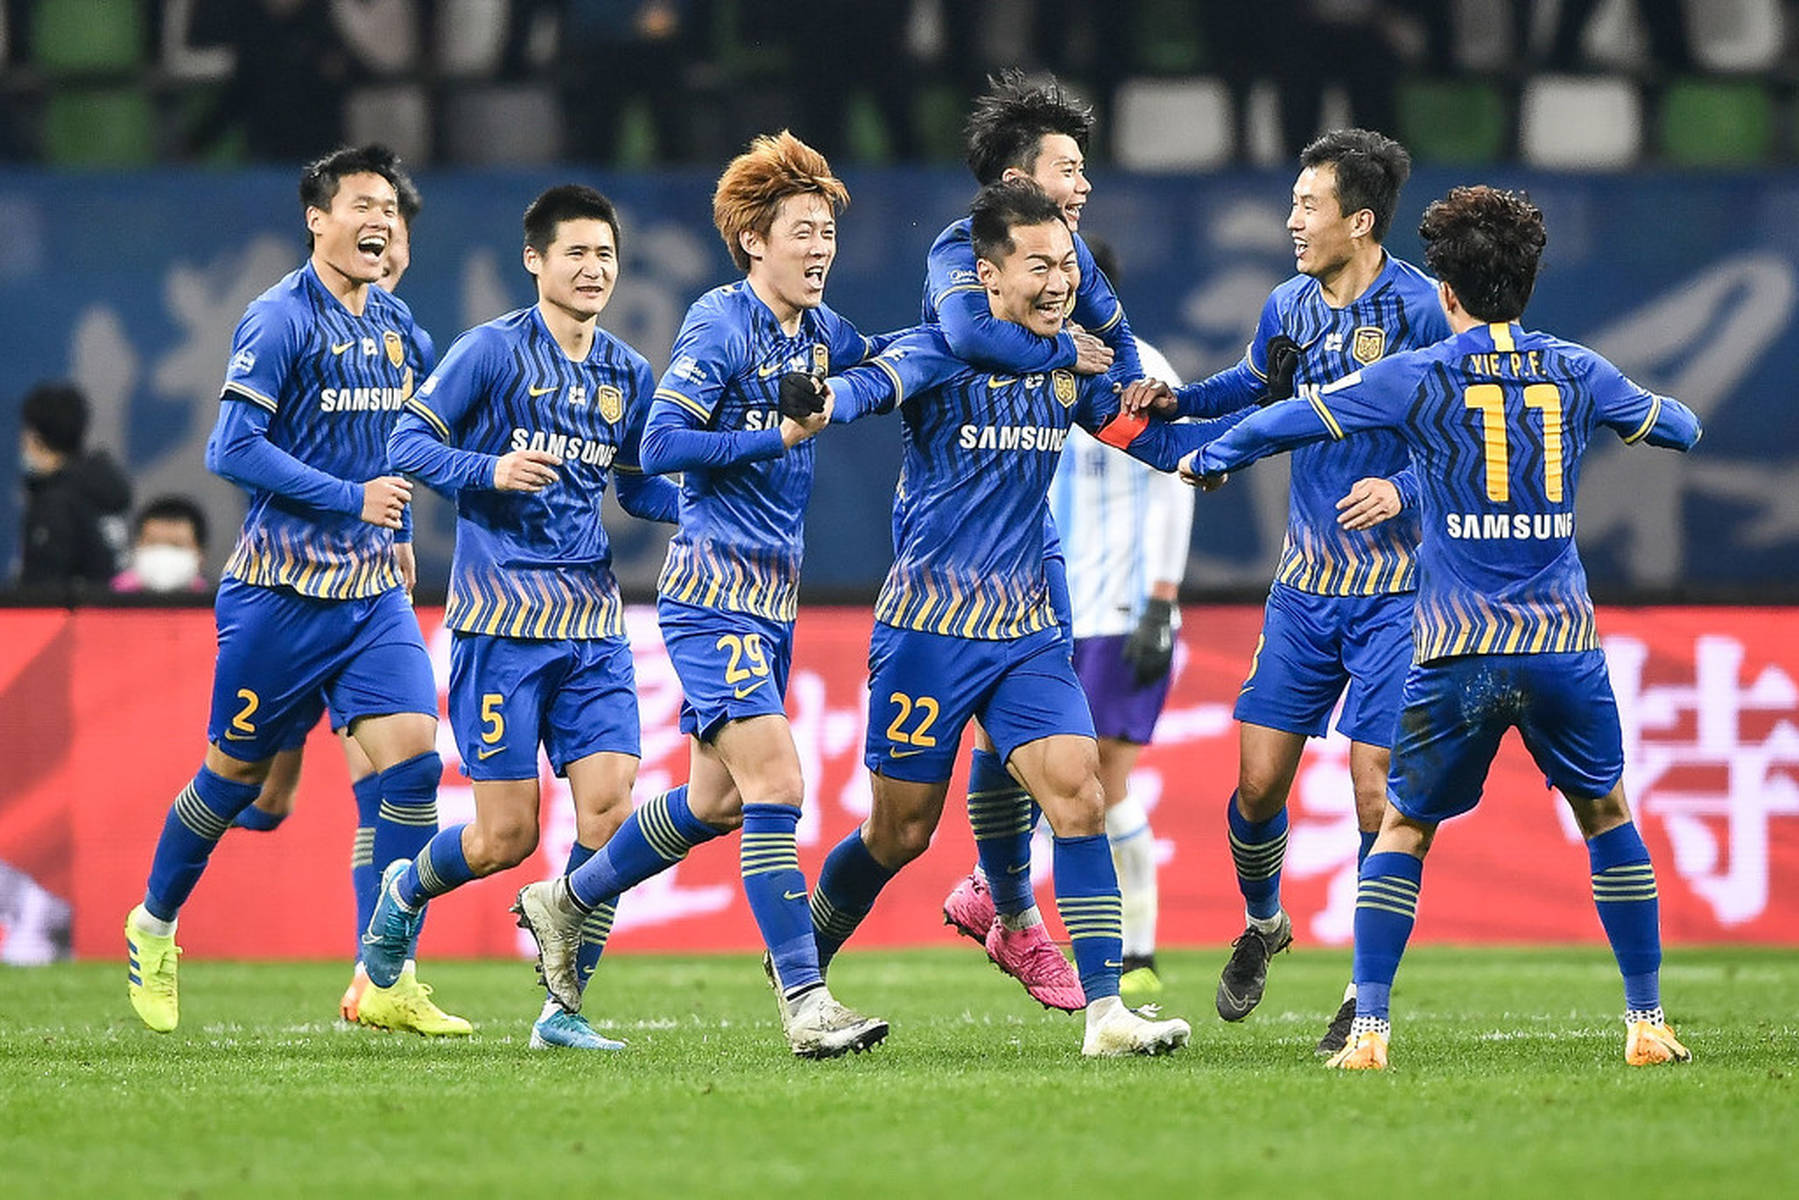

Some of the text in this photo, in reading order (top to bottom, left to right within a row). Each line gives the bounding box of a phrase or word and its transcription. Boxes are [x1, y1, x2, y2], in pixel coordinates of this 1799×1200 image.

[1470, 351, 1547, 377] XIE P.F.
[320, 387, 403, 412] SAMSUN
[959, 424, 1067, 452] SAMSUN
[1464, 384, 1564, 502] 11
[1446, 512, 1573, 539] SAMSUNG
[716, 633, 770, 684] 29
[232, 688, 259, 733] 2
[481, 693, 505, 744] 5
[886, 691, 940, 747] 22
